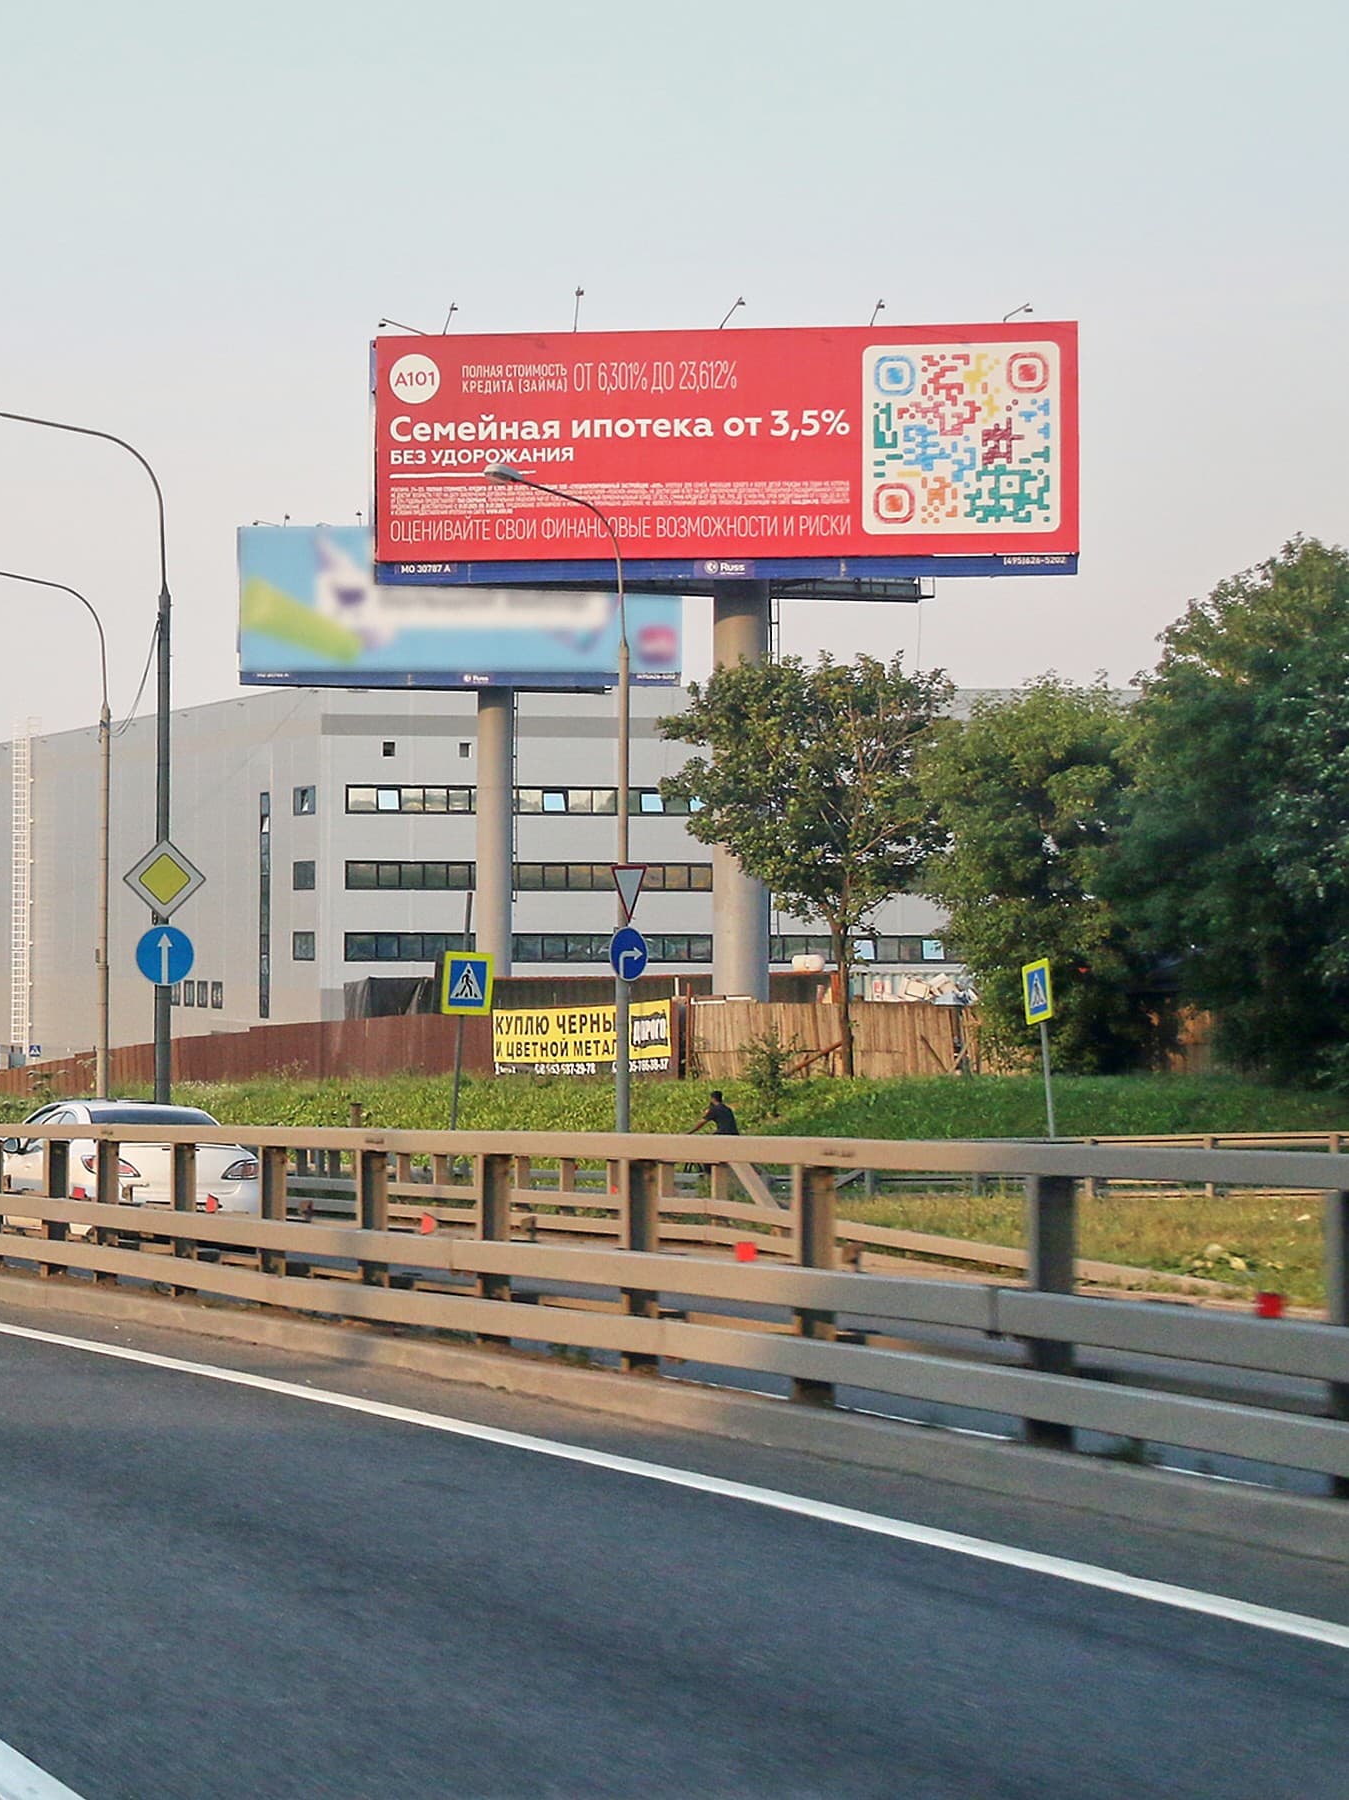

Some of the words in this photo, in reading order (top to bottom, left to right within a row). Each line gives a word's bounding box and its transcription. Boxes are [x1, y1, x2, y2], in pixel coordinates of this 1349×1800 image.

[462, 364, 502, 379] ПОЛНАЯ
[505, 363, 567, 378] СТОИМОСТЬ
[573, 362, 594, 392] ОТ
[598, 361, 648, 395] 6,301%
[650, 361, 675, 394] ДО
[679, 360, 737, 393] 23,612%
[462, 379, 514, 394] КРЕДИТА
[389, 414, 561, 442] Семейная
[571, 417, 714, 439] ипотека
[723, 416, 762, 437] от
[770, 408, 851, 441] 3,5%
[390, 448, 427, 465] БЕЗ
[431, 447, 574, 466] УДОРОЖАНИЯ
[390, 515, 491, 544] ОЦЕНИВАЙТЕ
[495, 519, 536, 541] СВОИ
[541, 516, 651, 540] ФИНАНСОВЫЕ
[656, 515, 778, 538] ВОЗМОЖНОСТИ
[783, 516, 794, 536] И
[799, 514, 851, 536] РИСКИ
[720, 562, 746, 572] Russ
[495, 1015, 549, 1036] КУПЛЮ
[556, 1012, 617, 1034] ЧЕРНЫ
[496, 1041, 502, 1057] И
[507, 1037, 568, 1060] ЦВЕТНОЙ
